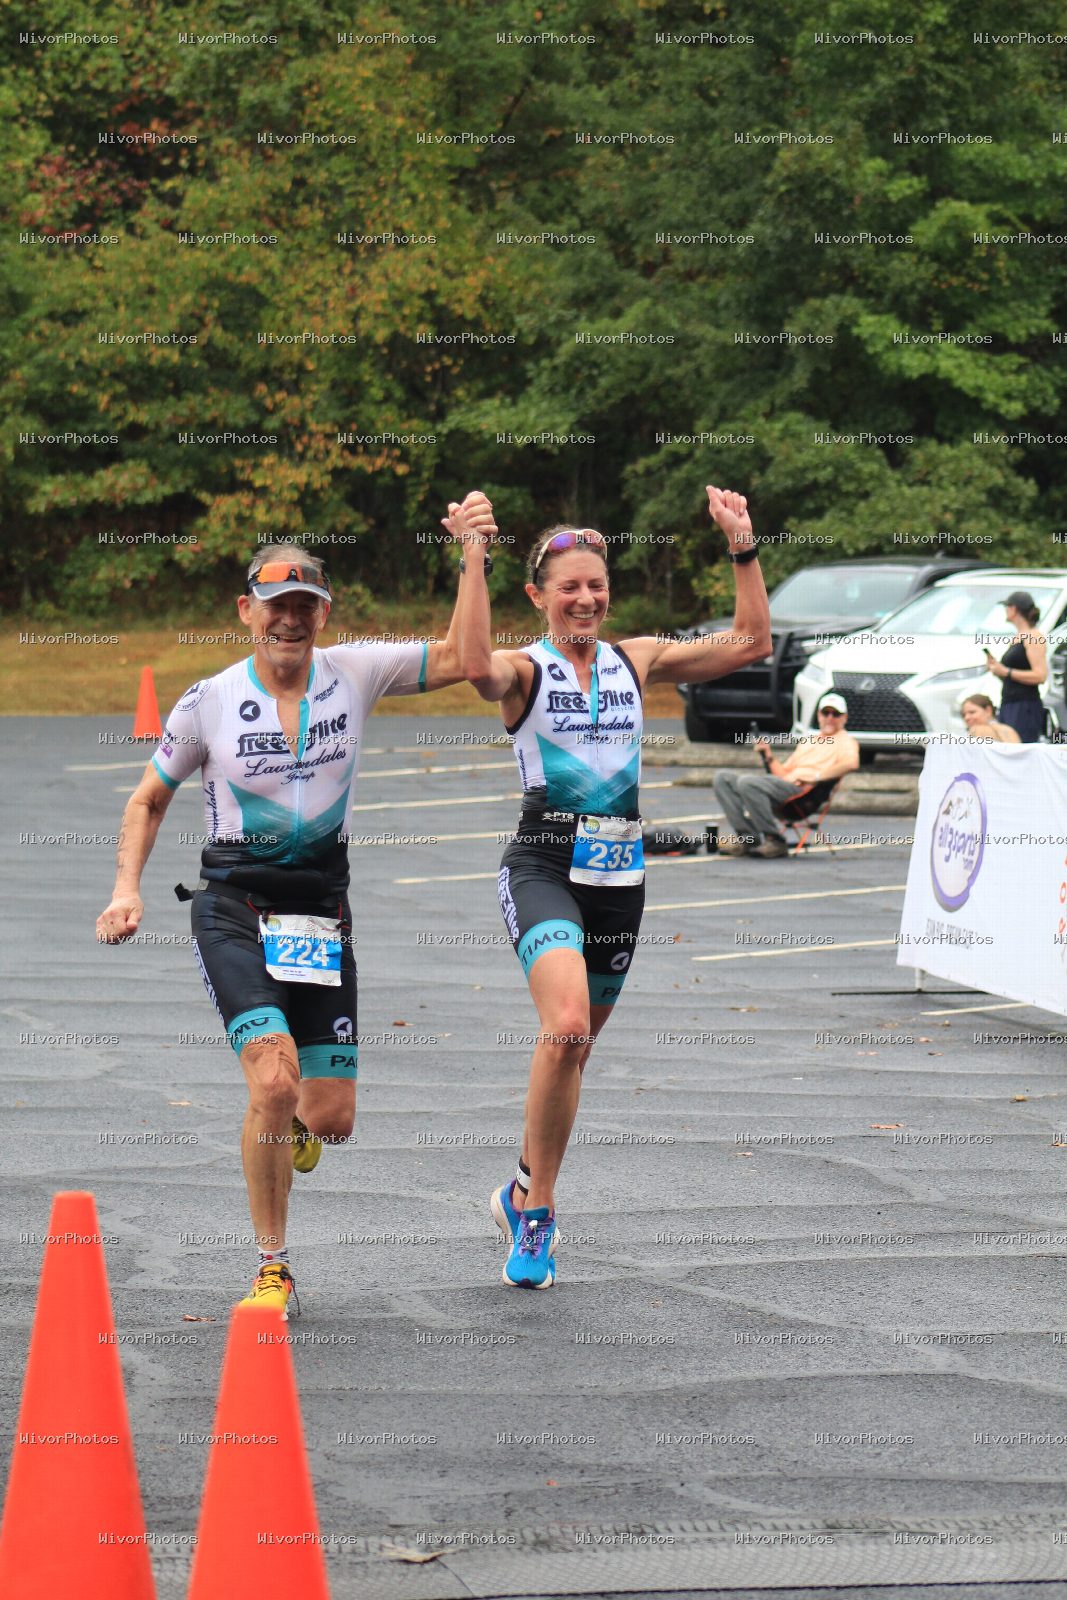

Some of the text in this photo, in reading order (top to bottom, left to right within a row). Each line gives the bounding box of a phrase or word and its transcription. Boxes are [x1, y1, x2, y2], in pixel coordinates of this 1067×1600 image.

[554, 811, 575, 819] PTS
[587, 843, 635, 869] 235
[277, 938, 330, 967] 224
